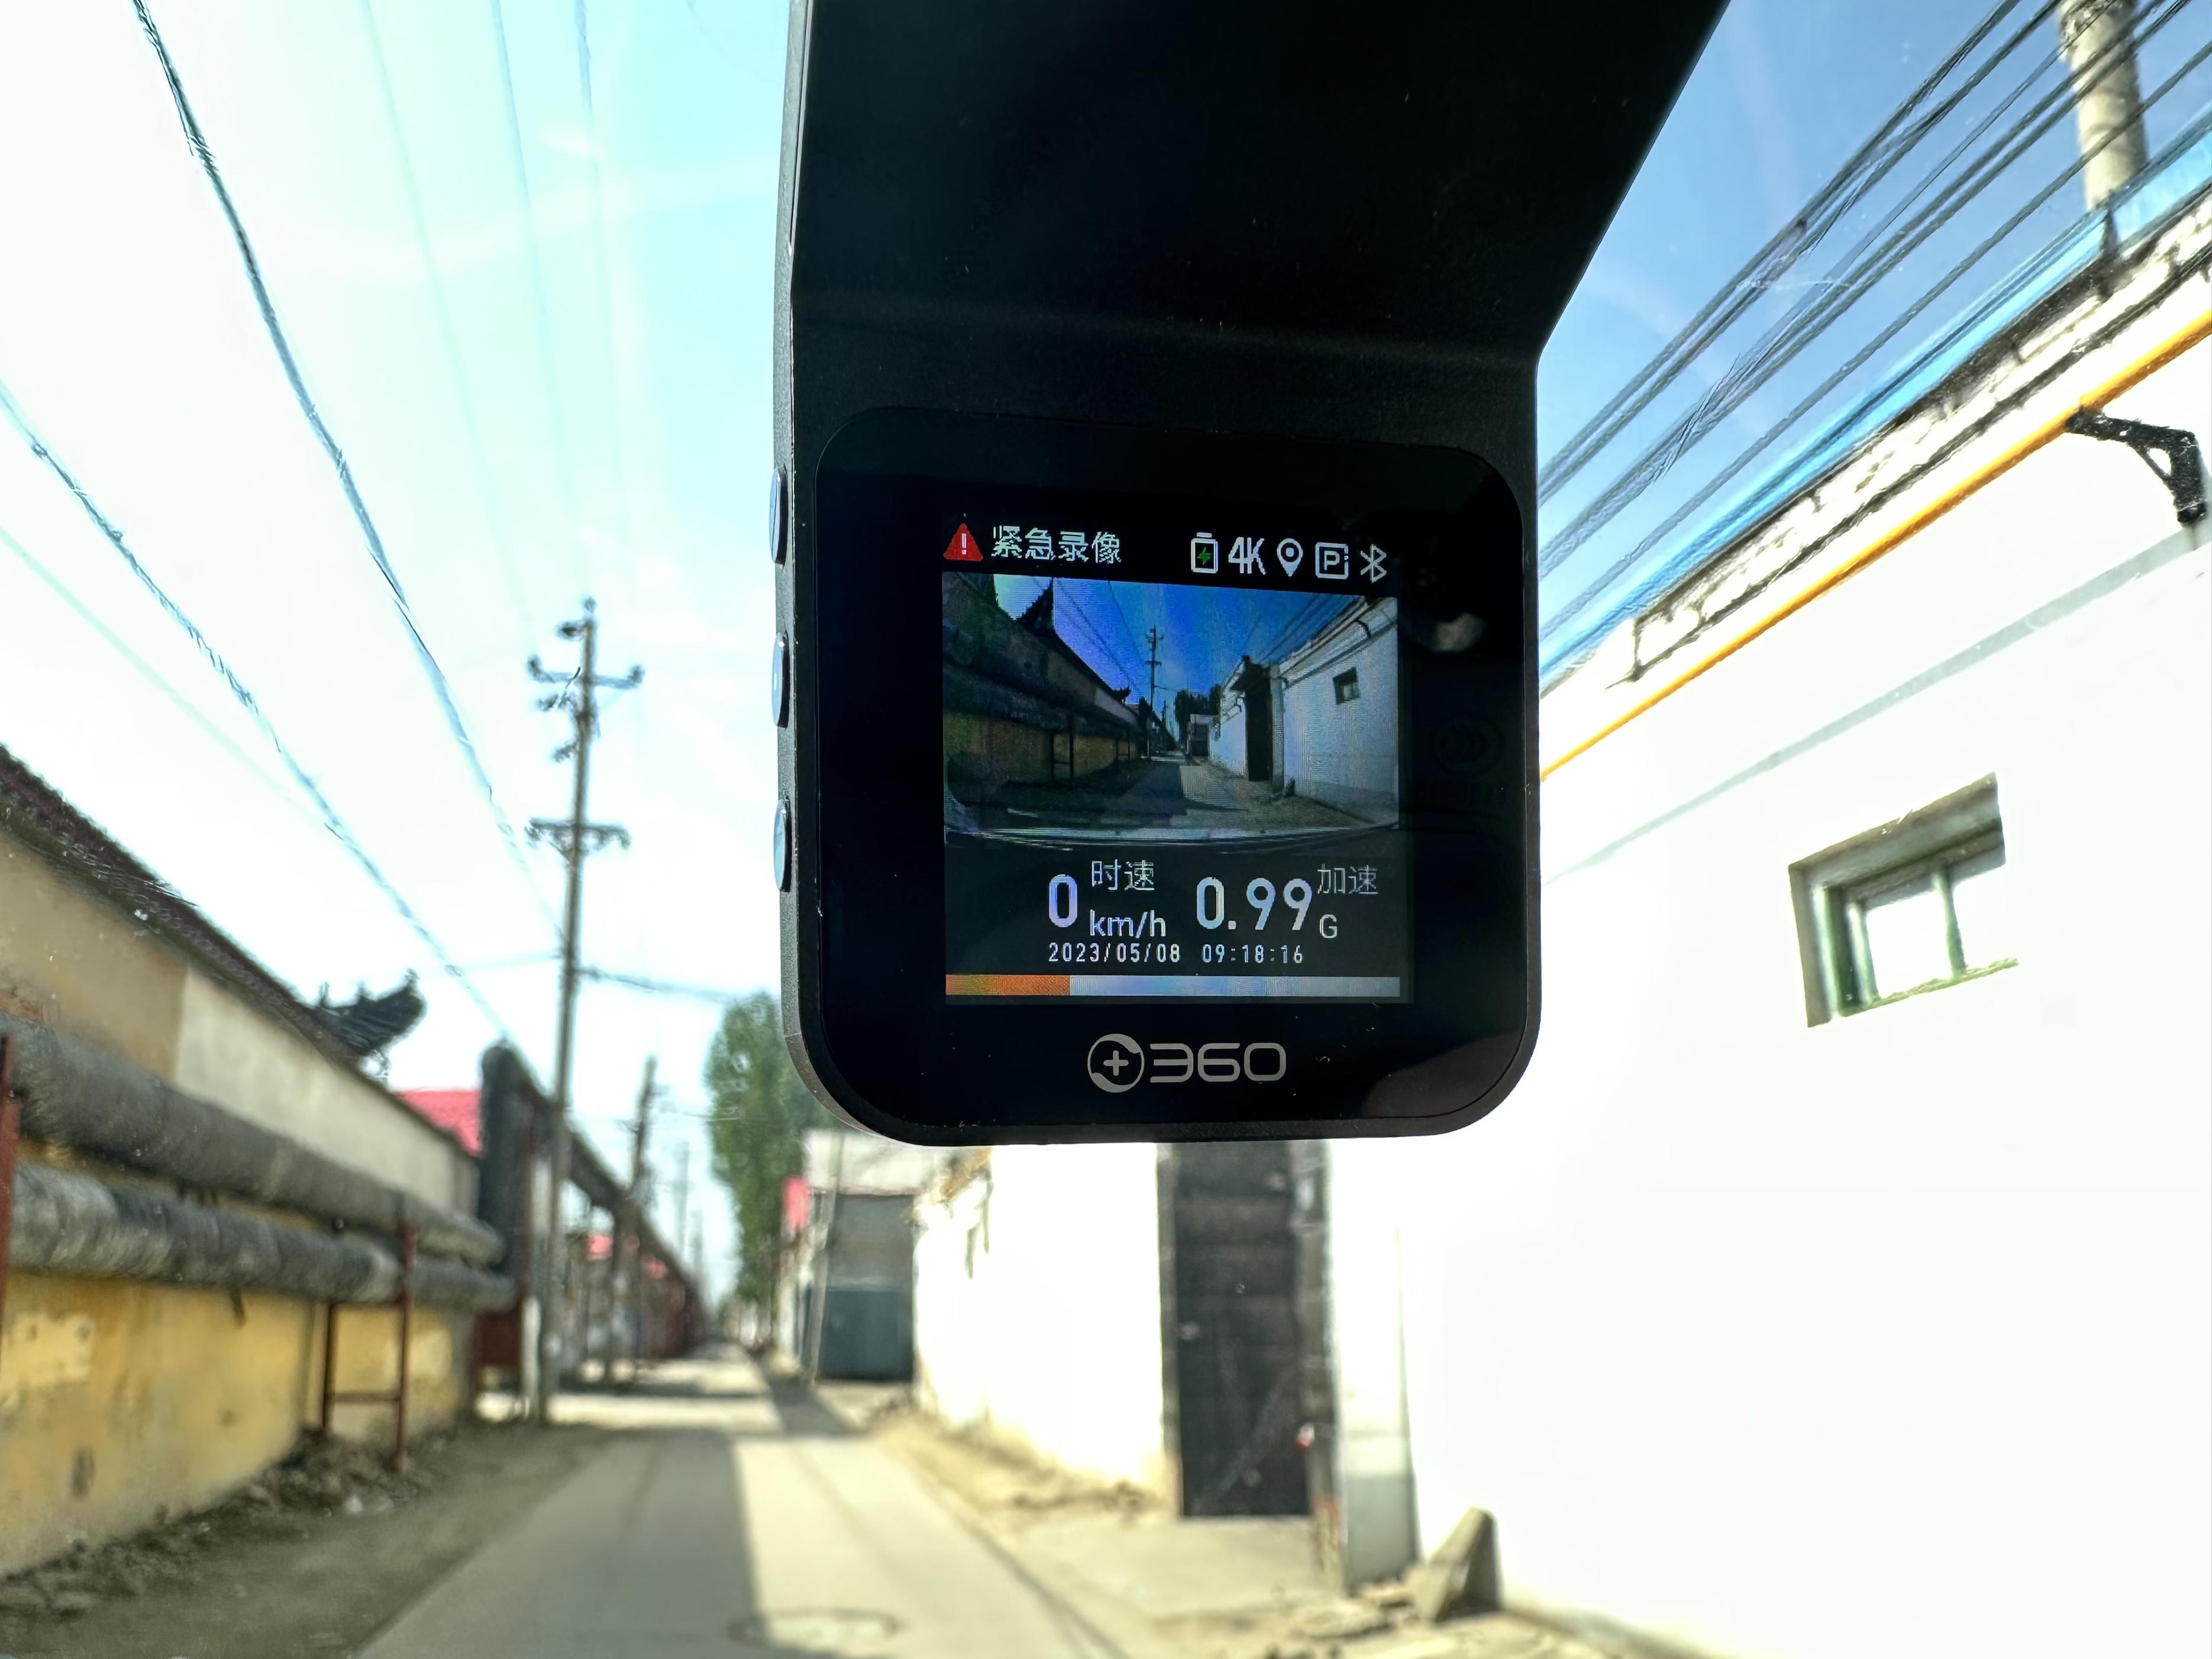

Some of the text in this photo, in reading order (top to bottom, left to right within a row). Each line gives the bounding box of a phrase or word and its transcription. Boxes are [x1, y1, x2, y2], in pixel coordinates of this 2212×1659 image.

[991, 525, 1122, 564] 紧急录像
[1228, 537, 1266, 575] 4K
[1091, 859, 1155, 890] 时速
[1317, 863, 1378, 894] 加速
[1048, 874, 1166, 938] 0 km/h
[1196, 876, 1338, 938] 0.99 G
[1048, 943, 1303, 963] 2023/05/08 09:18:16
[1149, 1042, 1286, 1083] 360
